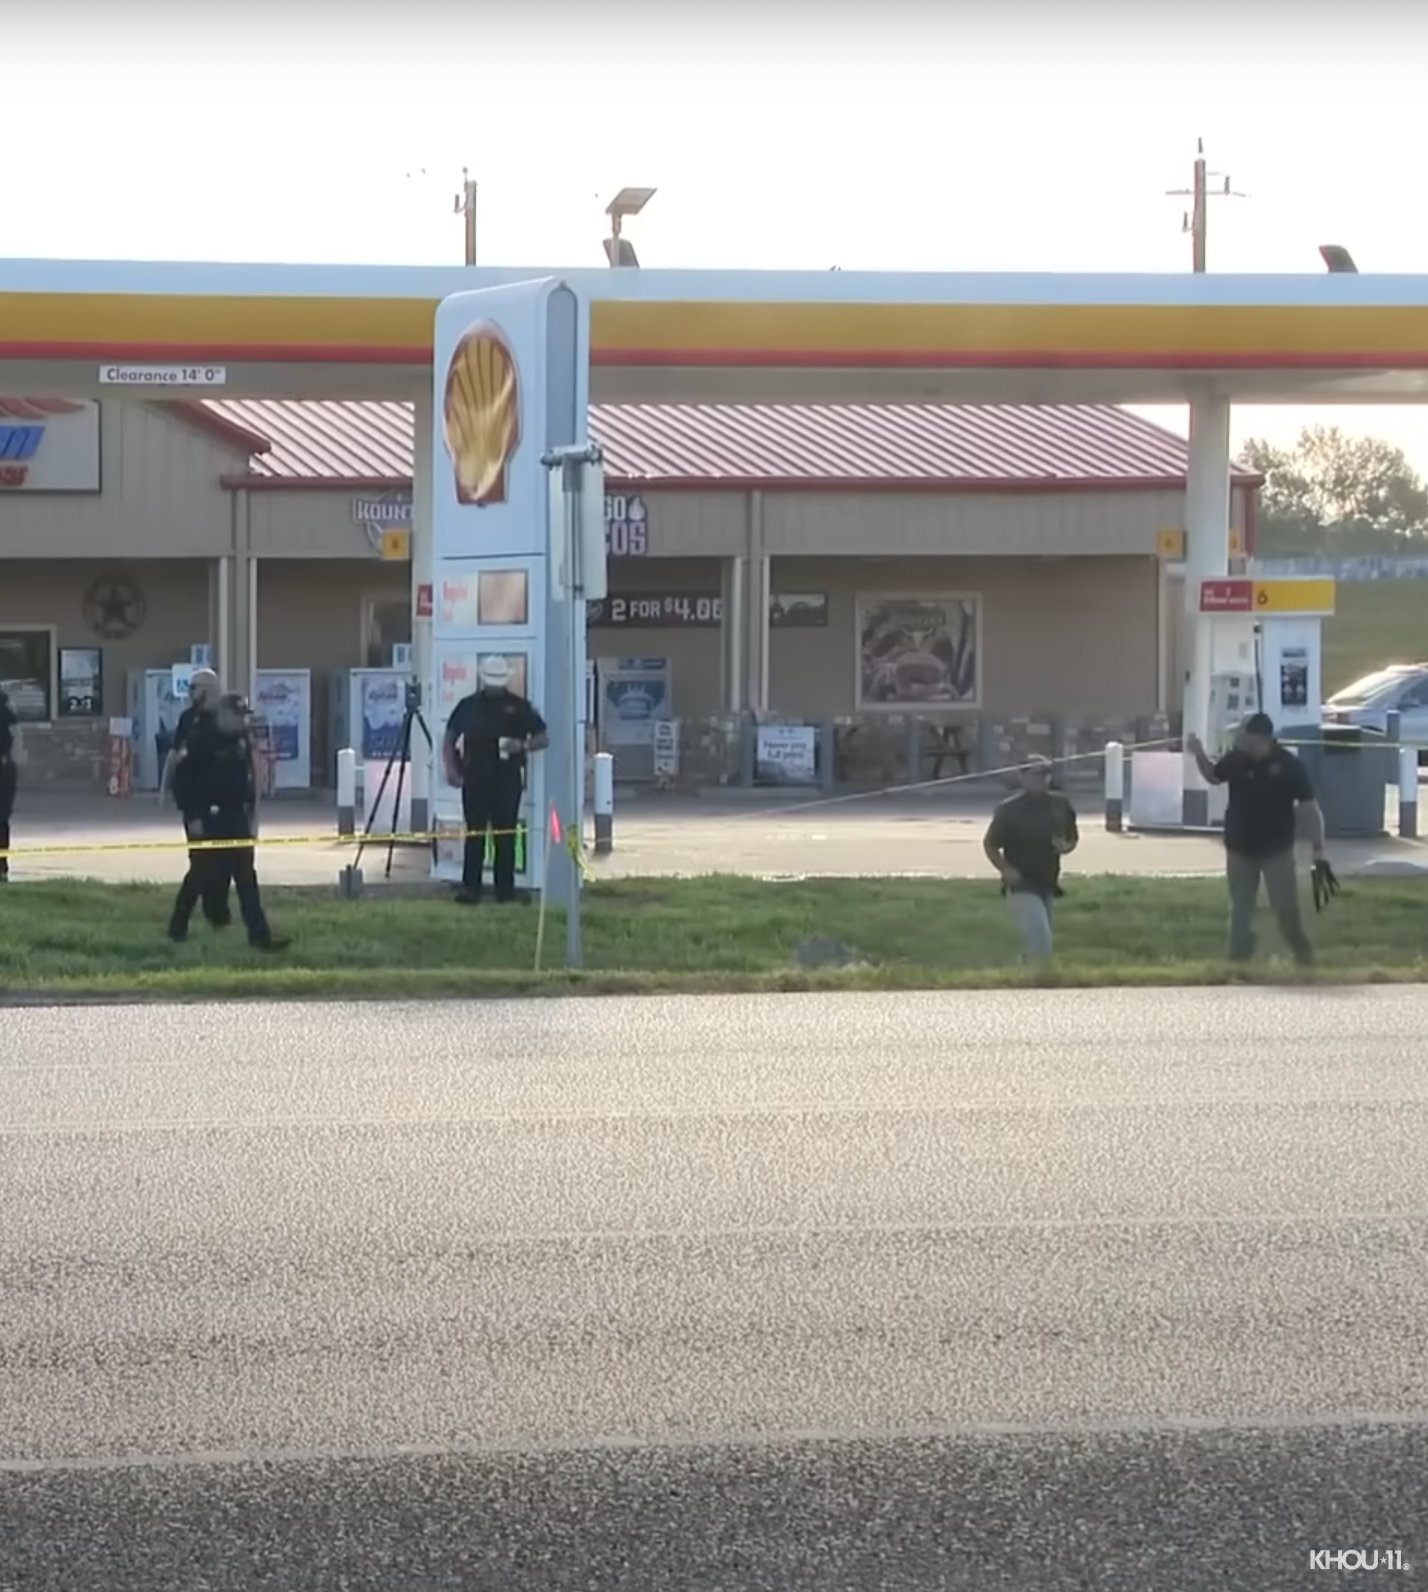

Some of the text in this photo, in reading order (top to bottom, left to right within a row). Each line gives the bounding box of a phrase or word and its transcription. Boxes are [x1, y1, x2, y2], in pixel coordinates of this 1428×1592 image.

[106, 367, 178, 382] Clearance
[357, 500, 414, 521] KOUNT
[1256, 589, 1268, 605] 6
[612, 598, 626, 621] 2
[630, 601, 661, 618] FOR
